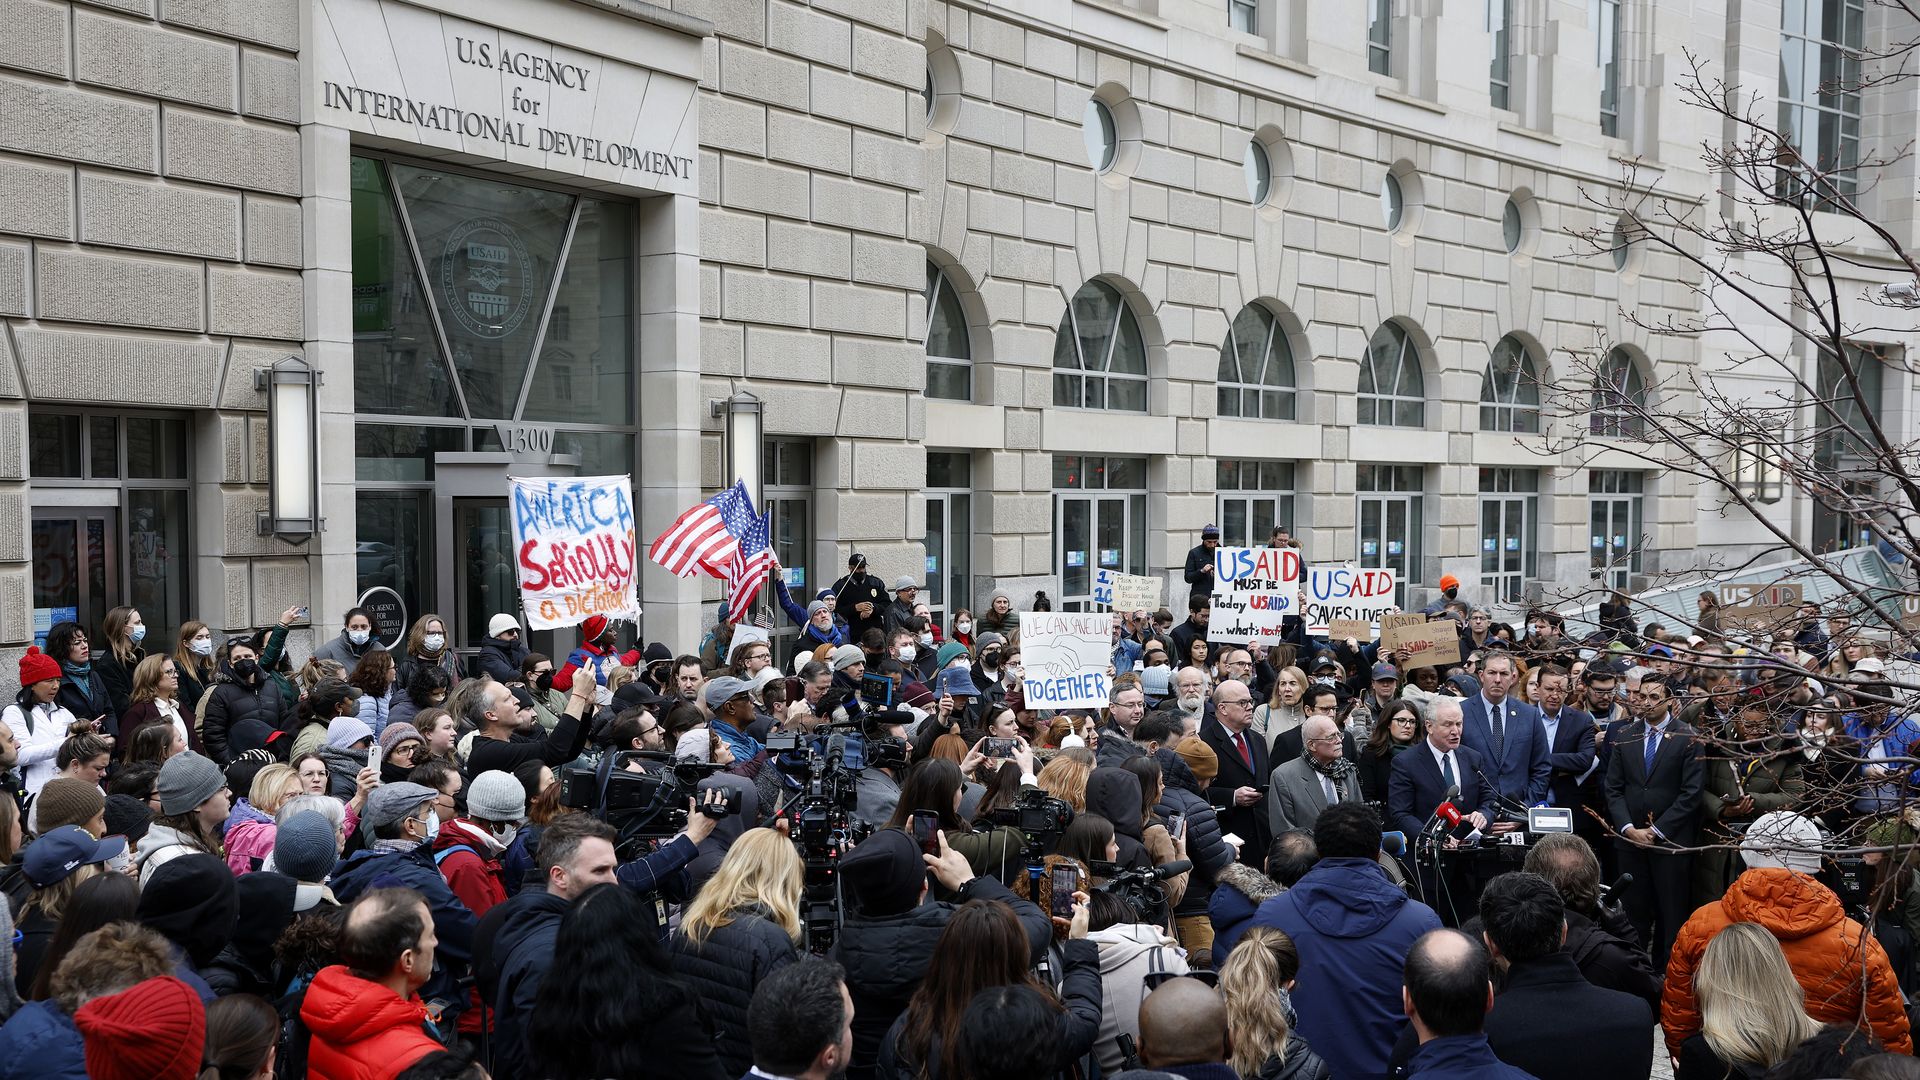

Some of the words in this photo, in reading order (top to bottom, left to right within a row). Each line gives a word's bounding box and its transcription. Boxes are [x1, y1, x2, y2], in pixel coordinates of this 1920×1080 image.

[455, 36, 493, 68] U.S.
[498, 48, 590, 92] AGENCY
[512, 86, 541, 116] for
[323, 80, 530, 148] INTERNATIONAL
[538, 127, 693, 180] DEVELOPMENT
[471, 247, 506, 261] USAID
[507, 428, 549, 453] 1300
[515, 482, 634, 544] AMERICA
[1216, 549, 1299, 583] USAID
[1233, 578, 1263, 591] MUST
[1266, 580, 1278, 590] BE
[1312, 570, 1393, 600] USAID
[376, 603, 396, 612] AGENCY
[1212, 593, 1246, 614] Today
[1722, 586, 1797, 609] USAID
[540, 599, 562, 621] a
[1307, 603, 1353, 627] SAVES
[1021, 615, 1044, 638] WE
[1046, 615, 1068, 634] CAN
[1070, 615, 1092, 635] SAVE
[1226, 618, 1259, 636] what's
[1384, 616, 1420, 630] USAID
[1024, 672, 1107, 703] TOGETHER
